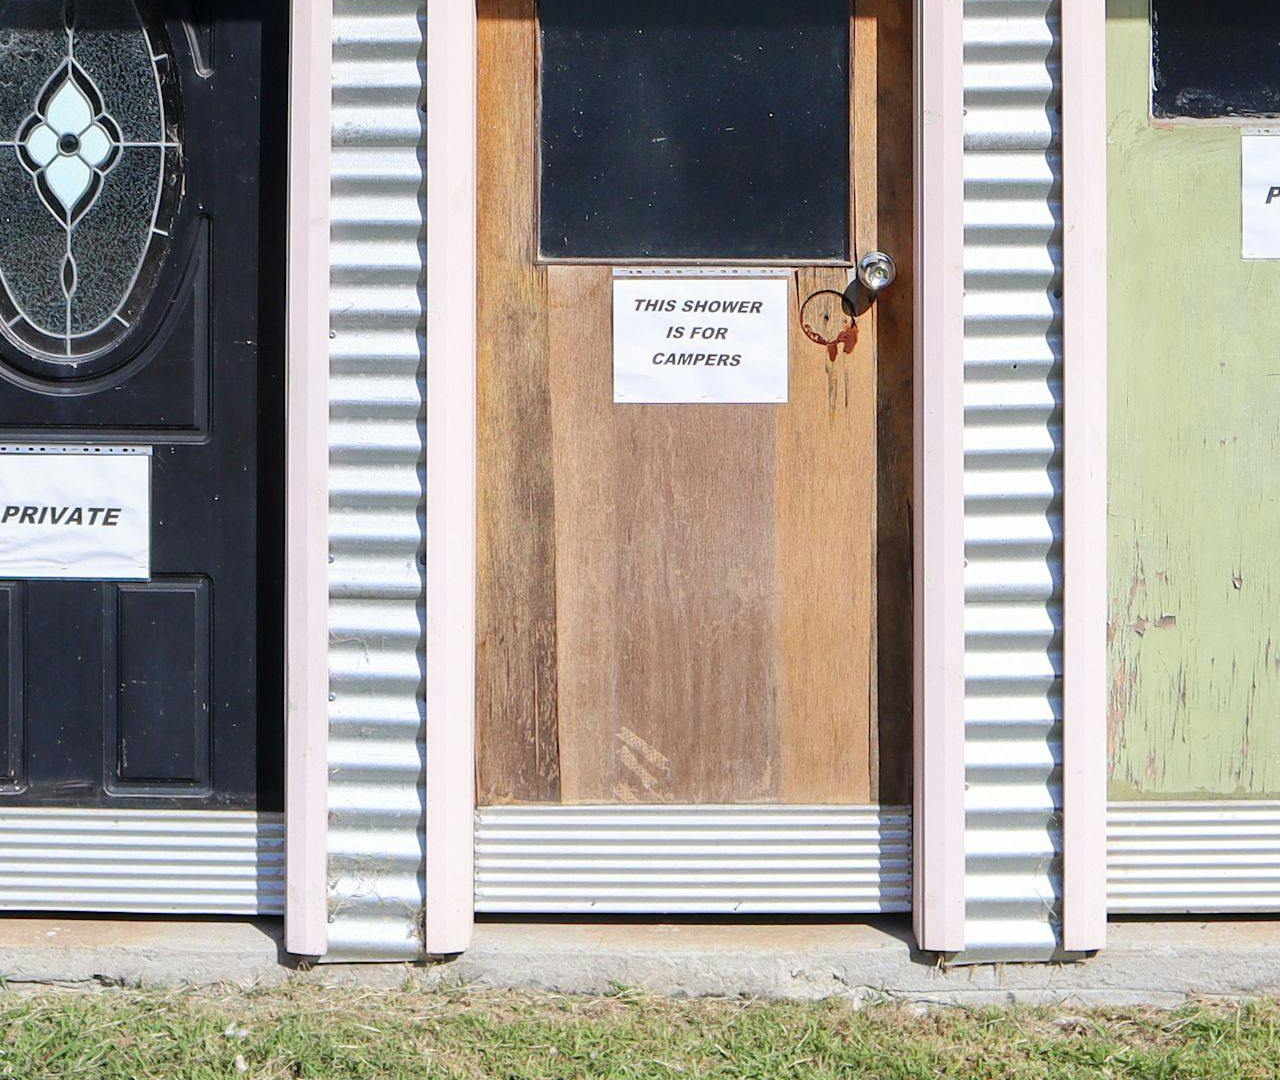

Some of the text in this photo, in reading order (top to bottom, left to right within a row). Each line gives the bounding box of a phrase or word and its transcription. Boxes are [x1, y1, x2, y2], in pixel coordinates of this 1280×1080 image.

[634, 299, 763, 314] THIS SHOWER
[666, 326, 729, 340] IS FOR
[651, 352, 742, 367] CAMPERS
[0, 505, 123, 527] PRIVATE
